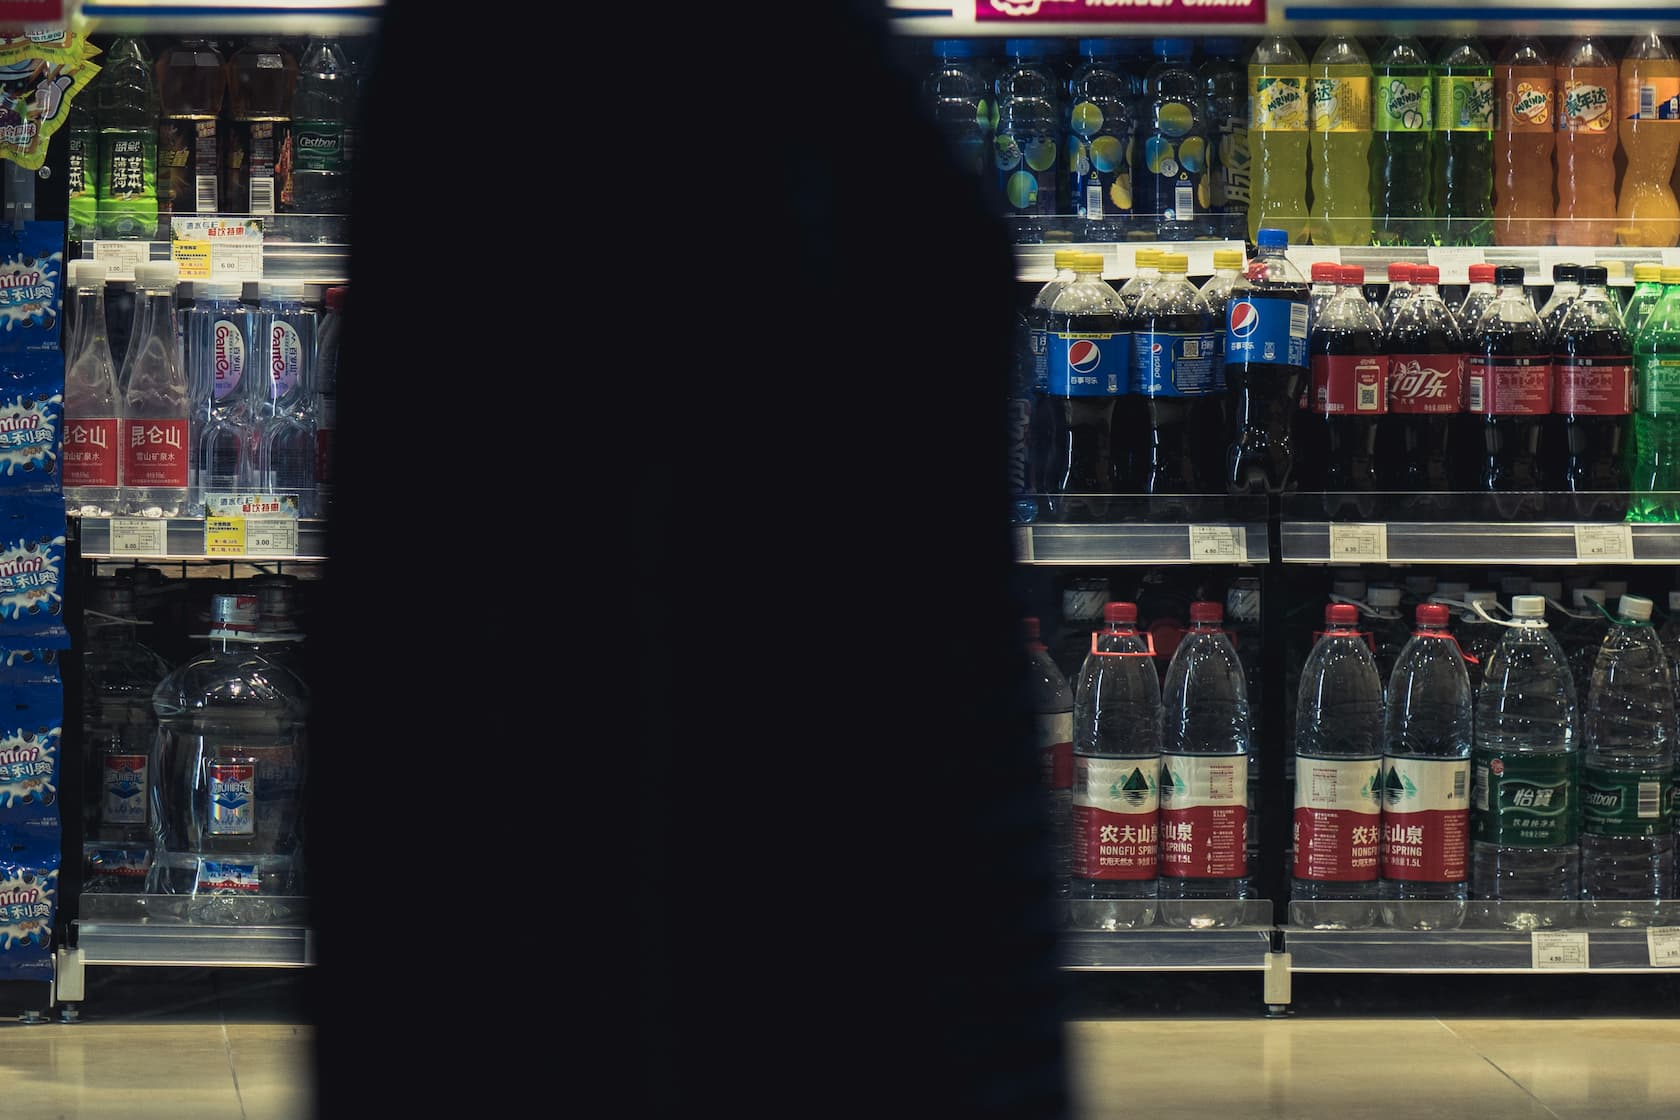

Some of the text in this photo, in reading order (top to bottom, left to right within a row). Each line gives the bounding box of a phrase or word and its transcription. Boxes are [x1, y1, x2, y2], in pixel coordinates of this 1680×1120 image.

[1267, 90, 1300, 112] MIRINDA
[1388, 93, 1421, 111] MIRINDA
[1514, 93, 1547, 116] MIRINDA
[1566, 90, 1608, 117] 美年达
[299, 137, 337, 149] Cestbon
[1389, 367, 1453, 398] 可乐
[132, 426, 182, 449] 昆仑山
[136, 451, 175, 462] 雪山矿泉水
[1585, 790, 1617, 806] stbon
[1163, 821, 1193, 841] 山泉
[1352, 826, 1378, 845] 农夫
[1384, 824, 1423, 845] 山泉
[1100, 845, 1136, 857] NONGFU
[1392, 845, 1422, 857] SPRING
[1406, 857, 1422, 868] 1.5L
